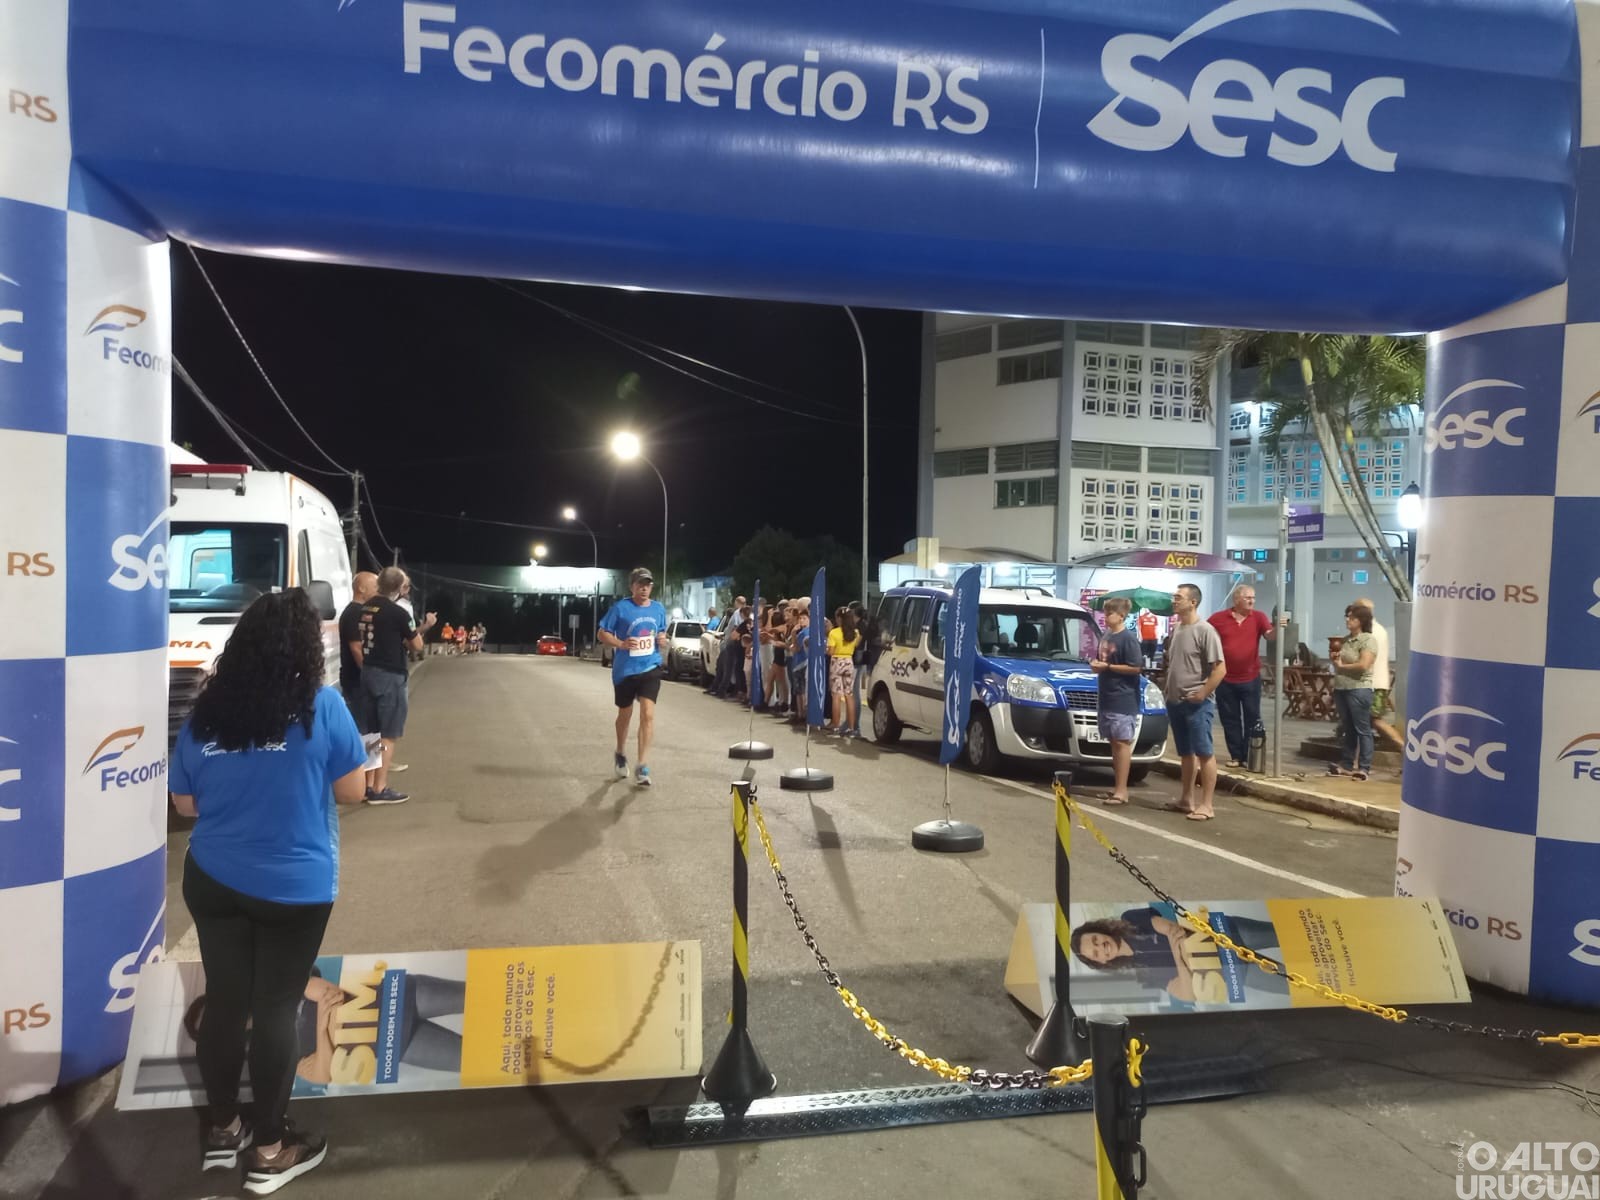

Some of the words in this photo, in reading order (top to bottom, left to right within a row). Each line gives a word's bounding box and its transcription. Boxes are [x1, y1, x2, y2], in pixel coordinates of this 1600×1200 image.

[403, 2, 867, 122] Fecomércio
[893, 59, 990, 134] RS
[8, 88, 58, 124] RS
[1086, 30, 1405, 172] Sesc
[1424, 407, 1527, 454] Sesc
[7, 551, 56, 577] RS
[1164, 552, 1198, 569] Açaí
[1503, 584, 1540, 604] RS
[891, 657, 910, 677] Sesc
[1405, 718, 1507, 781] Sesc
[1298, 909, 1315, 942] mundo
[1487, 916, 1522, 941] RS
[504, 963, 515, 1005] mundo
[517, 961, 525, 975] os
[4, 1002, 51, 1034] RS
[388, 997, 397, 1015] SER
[514, 978, 525, 1039] aproveitar
[524, 1000, 534, 1015] do
[386, 1016, 396, 1048] PODEM
[502, 1009, 512, 1038] todo
[543, 1007, 554, 1060] Inclusive
[384, 1049, 393, 1080] TODOS
[512, 1043, 523, 1075] pode
